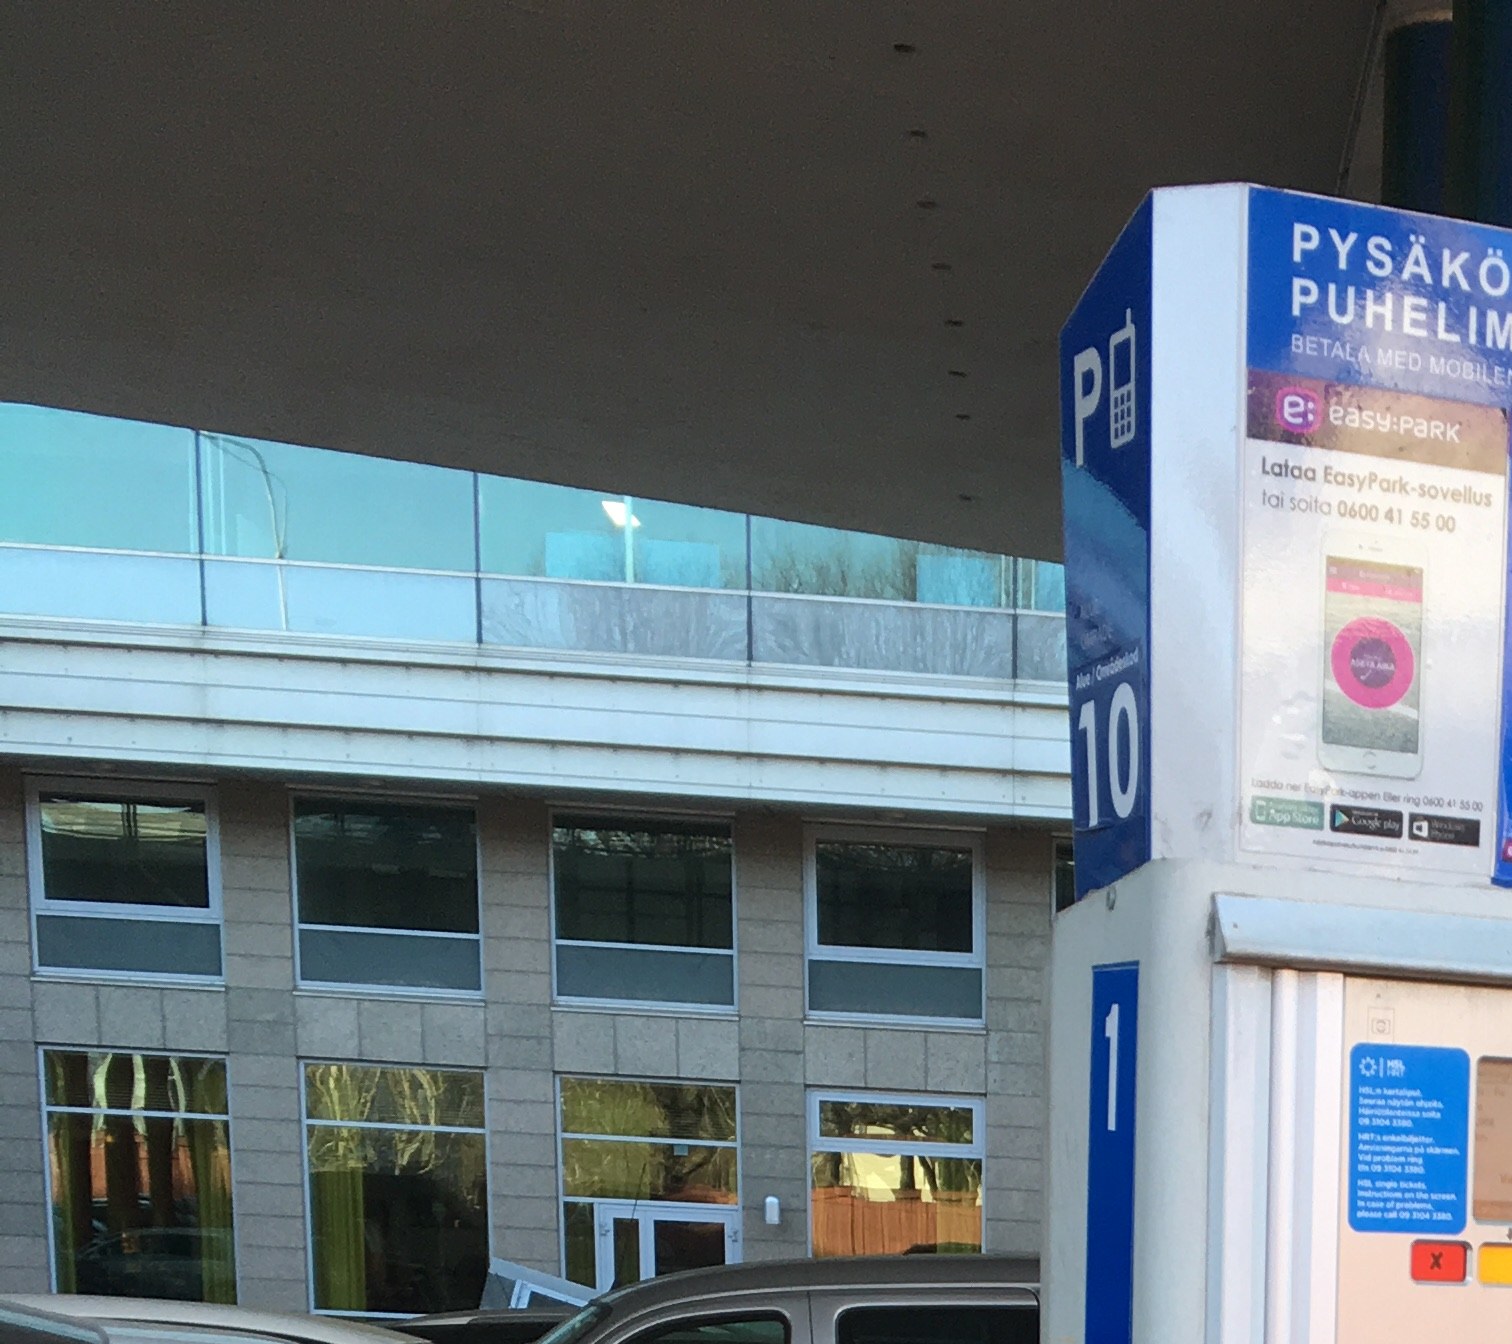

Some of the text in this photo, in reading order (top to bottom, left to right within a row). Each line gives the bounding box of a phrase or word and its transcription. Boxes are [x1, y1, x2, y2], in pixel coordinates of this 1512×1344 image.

[1291, 334, 1371, 364] BETALA
[1377, 348, 1421, 372] MED
[1074, 347, 1102, 468] P
[1262, 456, 1492, 508] Lataa EasyPark-sovellus
[1262, 489, 1456, 533] tai soita 0600 41 55 00
[1078, 682, 1139, 828] 10
[1251, 778, 1284, 790] Ladda
[1287, 783, 1301, 791] ner
[1404, 794, 1420, 808] ring
[1423, 796, 1444, 807] 0600
[1460, 800, 1470, 811] 55
[1472, 801, 1483, 812] 00
[1268, 811, 1319, 825] App Store
[1352, 816, 1400, 831] Google play
[1105, 1003, 1119, 1131] 1
